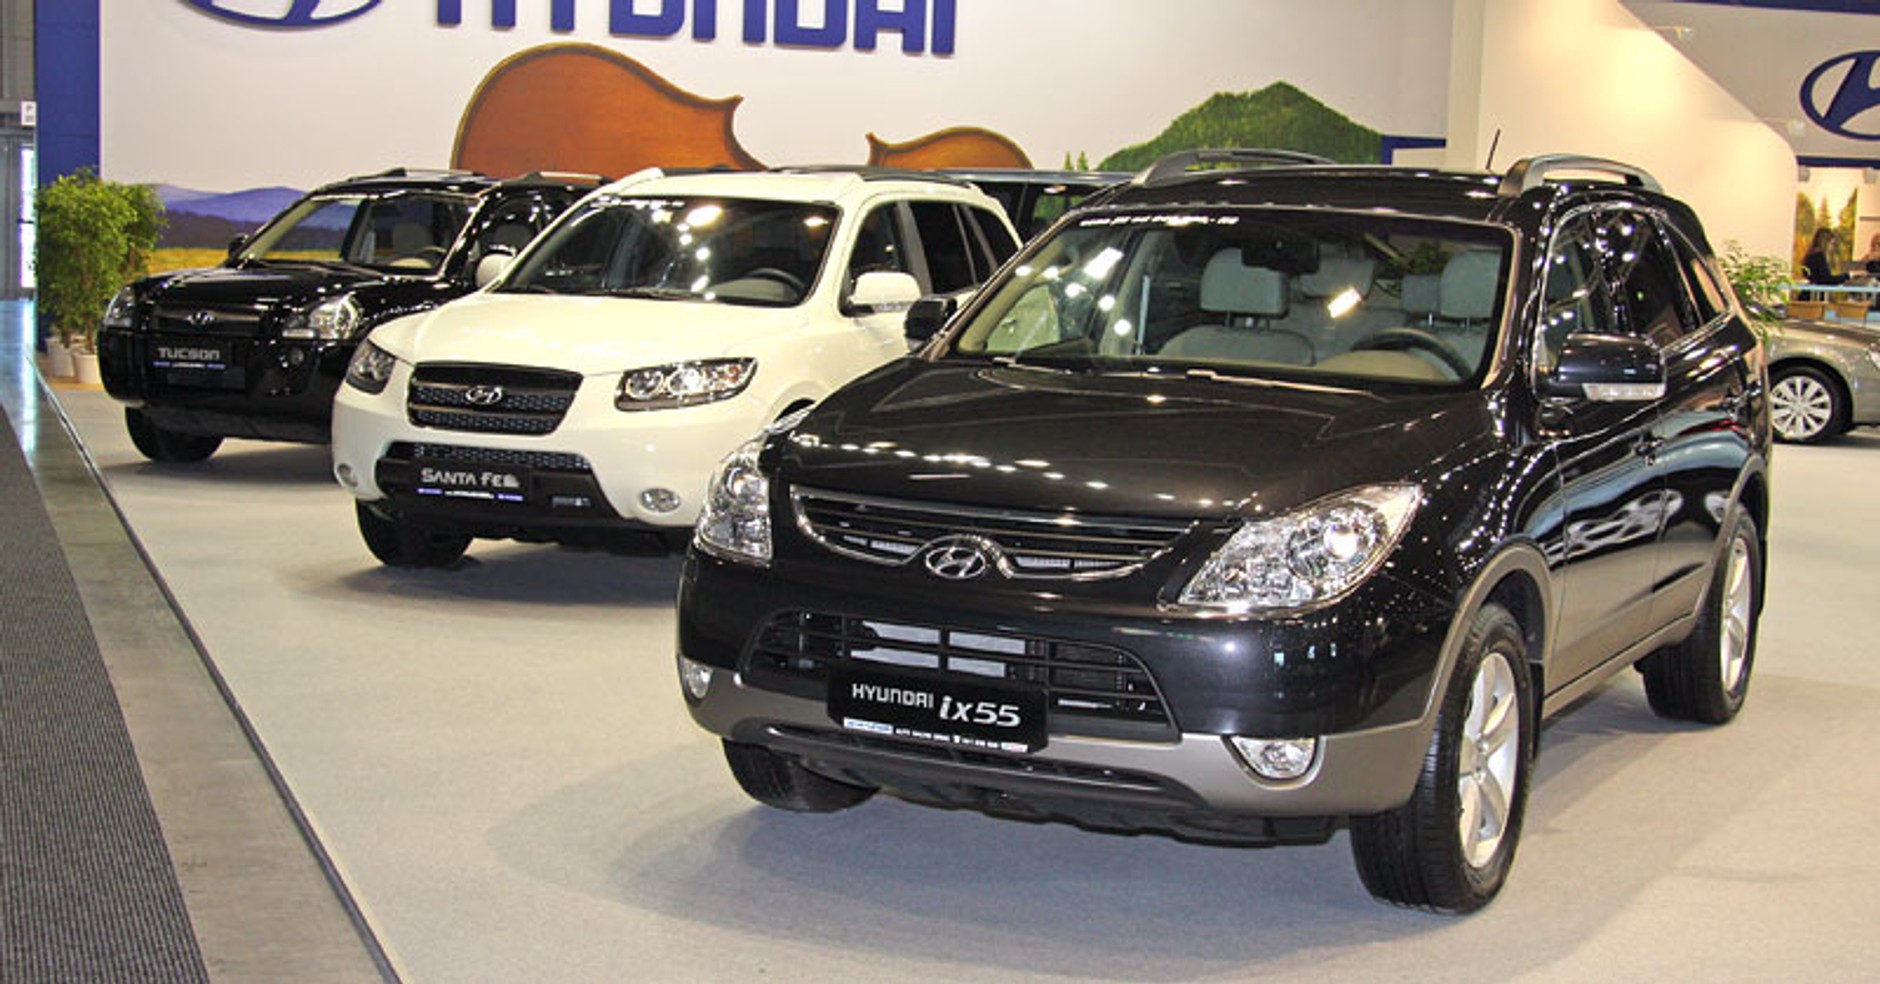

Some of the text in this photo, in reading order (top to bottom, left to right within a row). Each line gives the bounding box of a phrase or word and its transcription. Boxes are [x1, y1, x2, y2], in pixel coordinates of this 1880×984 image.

[157, 347, 220, 360] TUCSON
[421, 467, 476, 485] SANTA
[852, 683, 1021, 727] HYUNDAI ix55
